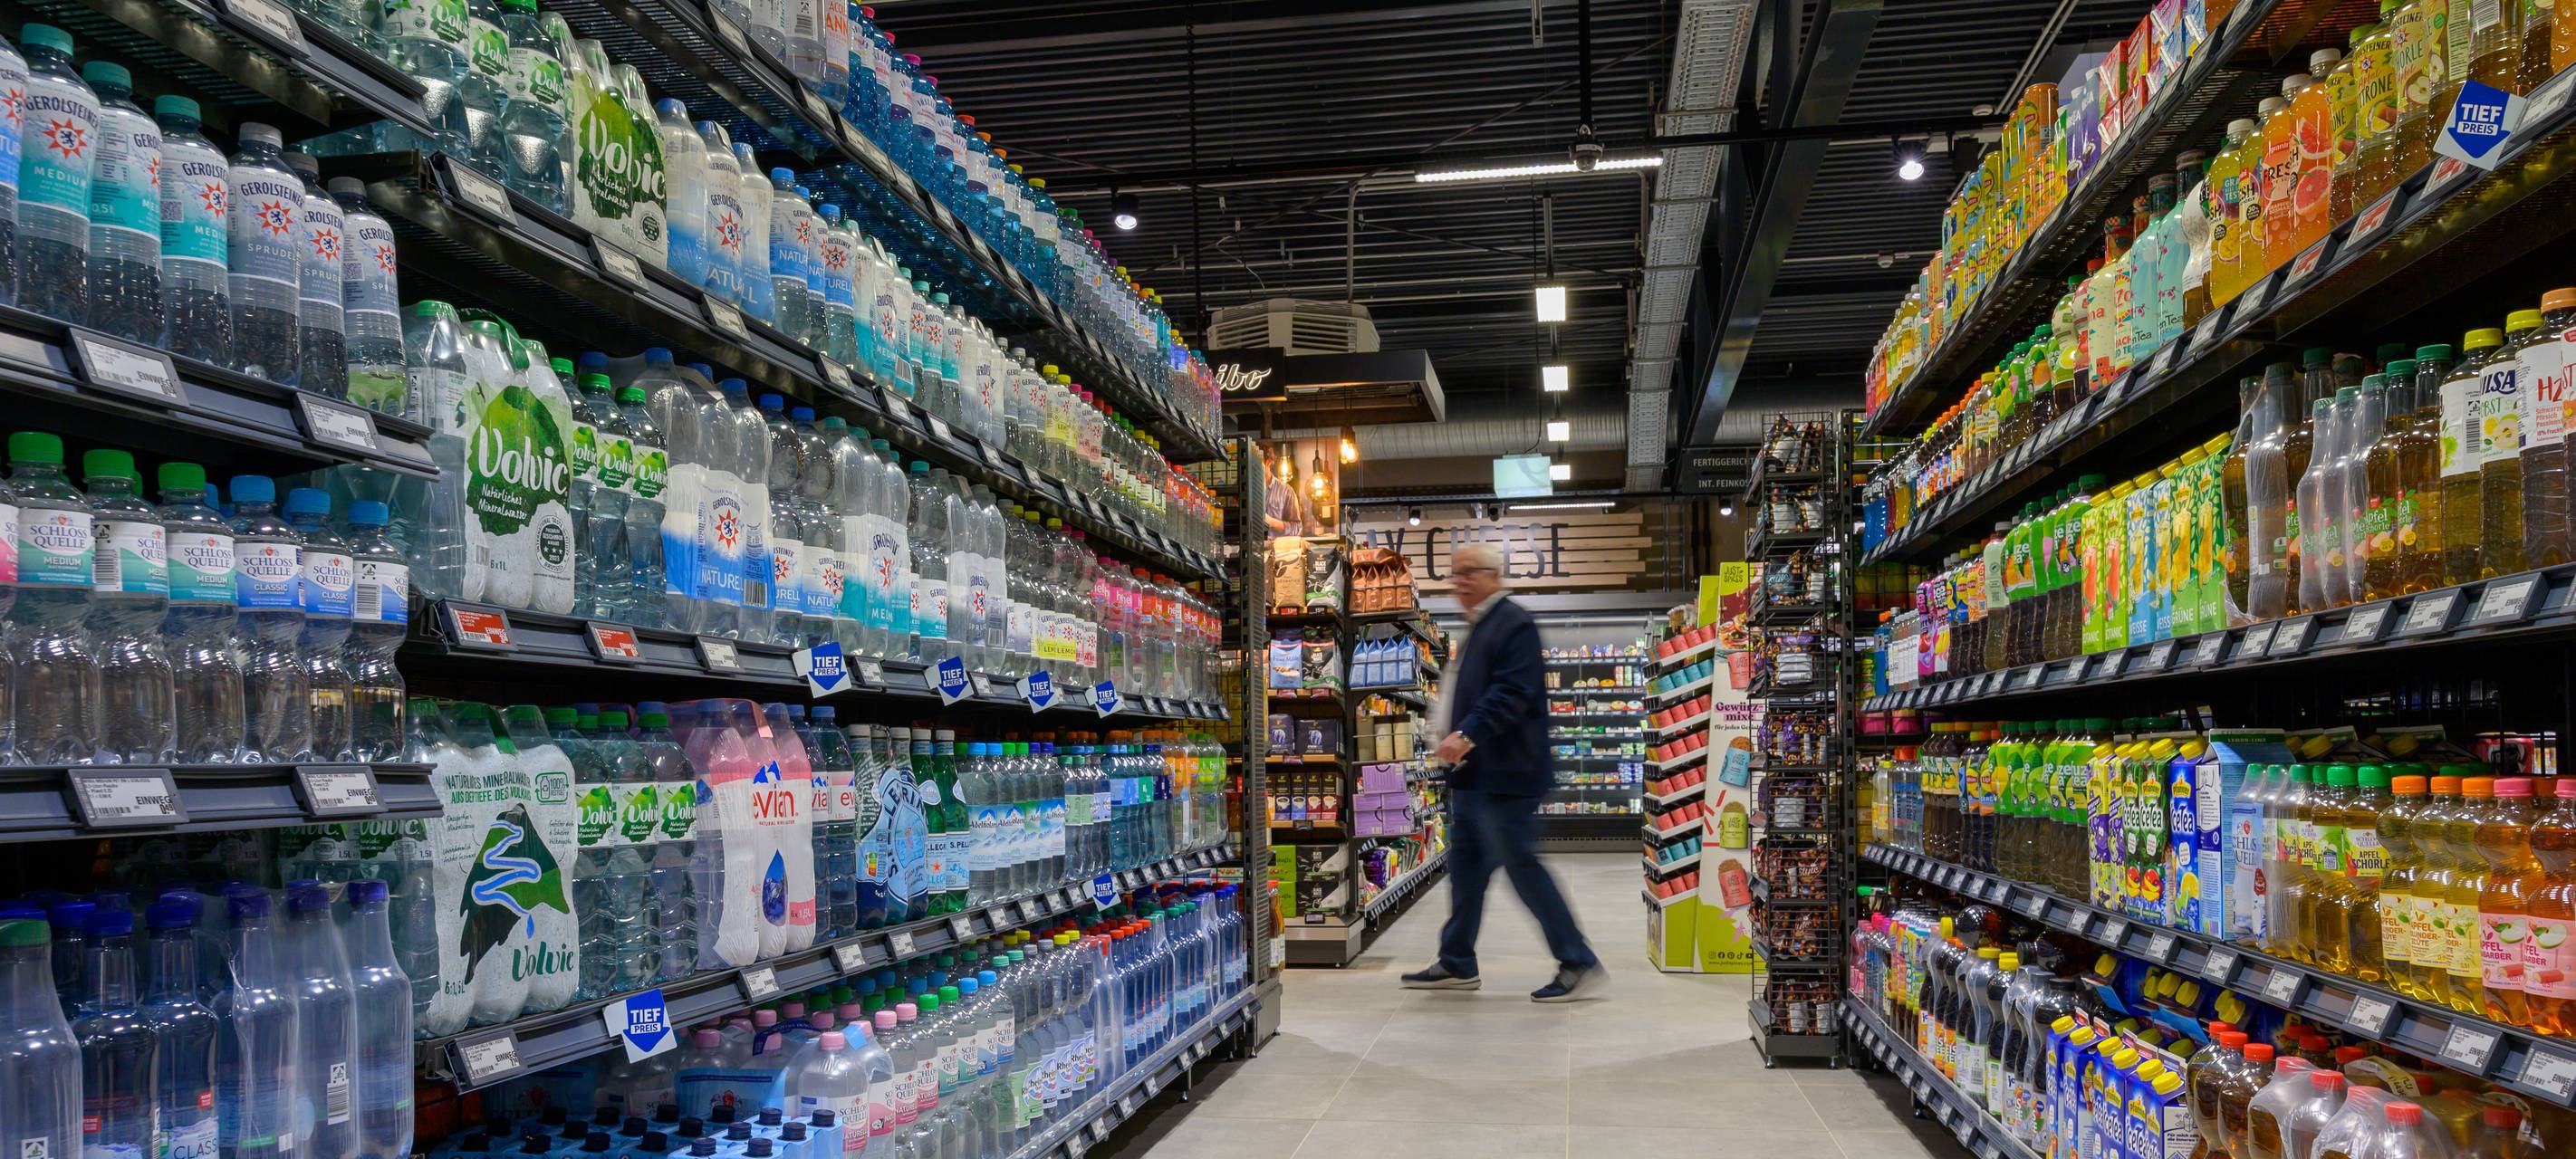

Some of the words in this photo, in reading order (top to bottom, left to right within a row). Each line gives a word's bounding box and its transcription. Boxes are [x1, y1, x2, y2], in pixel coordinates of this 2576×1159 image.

[25, 96, 99, 129] GEROLSTEINE
[2461, 103, 2503, 123] TIEF
[2462, 123, 2495, 135] PREIS
[34, 167, 87, 187] MEDIU
[182, 163, 226, 181] GEROLSTE
[2264, 162, 2292, 183] FRES
[241, 181, 304, 208] GEROLSTEINER
[195, 225, 226, 239] MEDI
[828, 237, 851, 251] OLSTEINER
[779, 249, 808, 266] NATUR
[304, 267, 341, 283] SPRUD
[371, 281, 398, 294] SPRU
[1216, 363, 1272, 391] ibo
[2483, 369, 2517, 396] ILSA
[2483, 397, 2503, 417] BST
[479, 424, 569, 496] Volvic
[1693, 457, 1754, 467] FERTIGGERICHT
[1716, 478, 1750, 488] FEINKOS
[30, 524, 88, 540] SCHLOSS
[34, 535, 86, 550] QUELLE
[138, 538, 167, 550] SCHL
[141, 547, 167, 560] QUEL
[184, 547, 232, 560] SCHLOSS
[43, 556, 82, 567] MEDIUM
[188, 557, 231, 570] QUELLE
[243, 557, 293, 569] SCHLOSS
[246, 566, 291, 578] QUELLE
[312, 566, 351, 579] SCHLOS
[197, 574, 228, 585] MEDIUM
[701, 570, 744, 591] NATURE
[255, 583, 289, 593] CLASSIC
[807, 594, 834, 608] NATU
[1057, 647, 1076, 655] LEMO
[815, 656, 840, 667] TIEF
[817, 667, 838, 675] PREIS
[941, 668, 962, 679] TIEF
[1031, 681, 1049, 691] TIEF
[1098, 690, 1113, 699] TIEF
[346, 789, 374, 798] EINWEG
[812, 787, 828, 809] via
[136, 796, 172, 806] EINWEG
[2359, 851, 2379, 859] APFEL
[2352, 858, 2390, 869] SCHORLE
[2383, 917, 2399, 926] PFEL
[2482, 941, 2504, 953] PFEL
[512, 941, 575, 982] Volvic
[630, 1008, 661, 1024] TIEF
[634, 1023, 659, 1033] PREIS
[173, 1138, 218, 1159] CLASS
